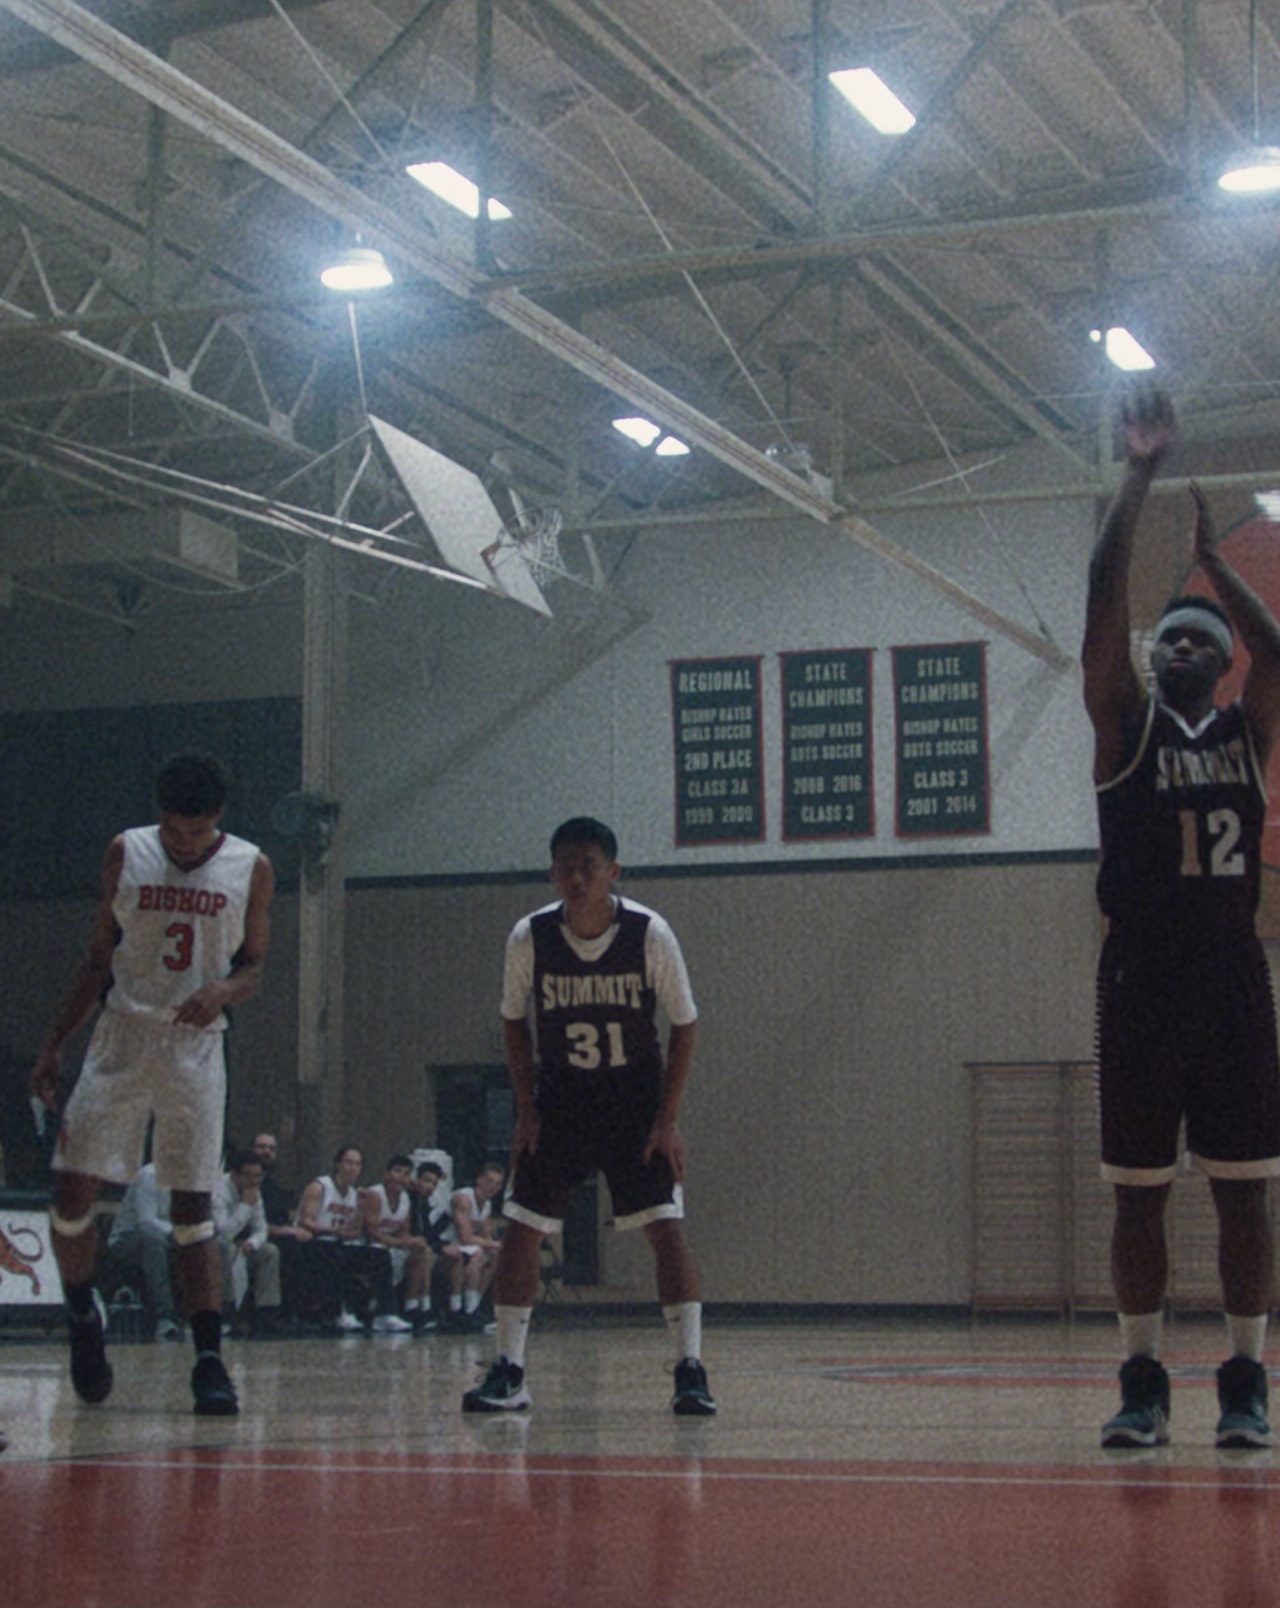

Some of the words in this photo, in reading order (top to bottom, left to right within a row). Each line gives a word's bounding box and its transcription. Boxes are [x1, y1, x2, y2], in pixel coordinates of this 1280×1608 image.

[804, 663, 847, 682] STATE
[917, 657, 961, 678] STATE
[679, 671, 752, 693] REGIONAL
[901, 682, 978, 703] CHAMPIONS
[789, 687, 863, 708] CHAMPIONS
[681, 708, 717, 724] BISHOP
[903, 720, 941, 736] BISHOP
[943, 717, 978, 733] HAYES
[681, 727, 711, 743] GIRLS
[713, 725, 752, 741] SOCCER
[790, 725, 826, 740] BISHOP
[828, 722, 863, 738] HAYES
[822, 744, 863, 760] SOCCER
[903, 742, 933, 759] BOYS
[936, 739, 978, 756] SOCCER
[684, 752, 710, 771] 2ND
[712, 749, 752, 769] PLACE
[688, 779, 727, 798] CLASS
[730, 778, 749, 795] 3A
[832, 775, 862, 793] 2016
[913, 771, 955, 790] CLASS
[958, 769, 968, 786] 3
[685, 806, 714, 825] 1999
[801, 805, 842, 824] CLASS
[844, 804, 854, 822] 3
[907, 797, 938, 816] 2001
[946, 795, 977, 814] 2014
[1178, 807, 1246, 877] 12
[136, 884, 229, 917] BISHOP
[163, 923, 196, 972] 3
[541, 973, 644, 1011] SUMMIT
[565, 1021, 628, 1071] 31
